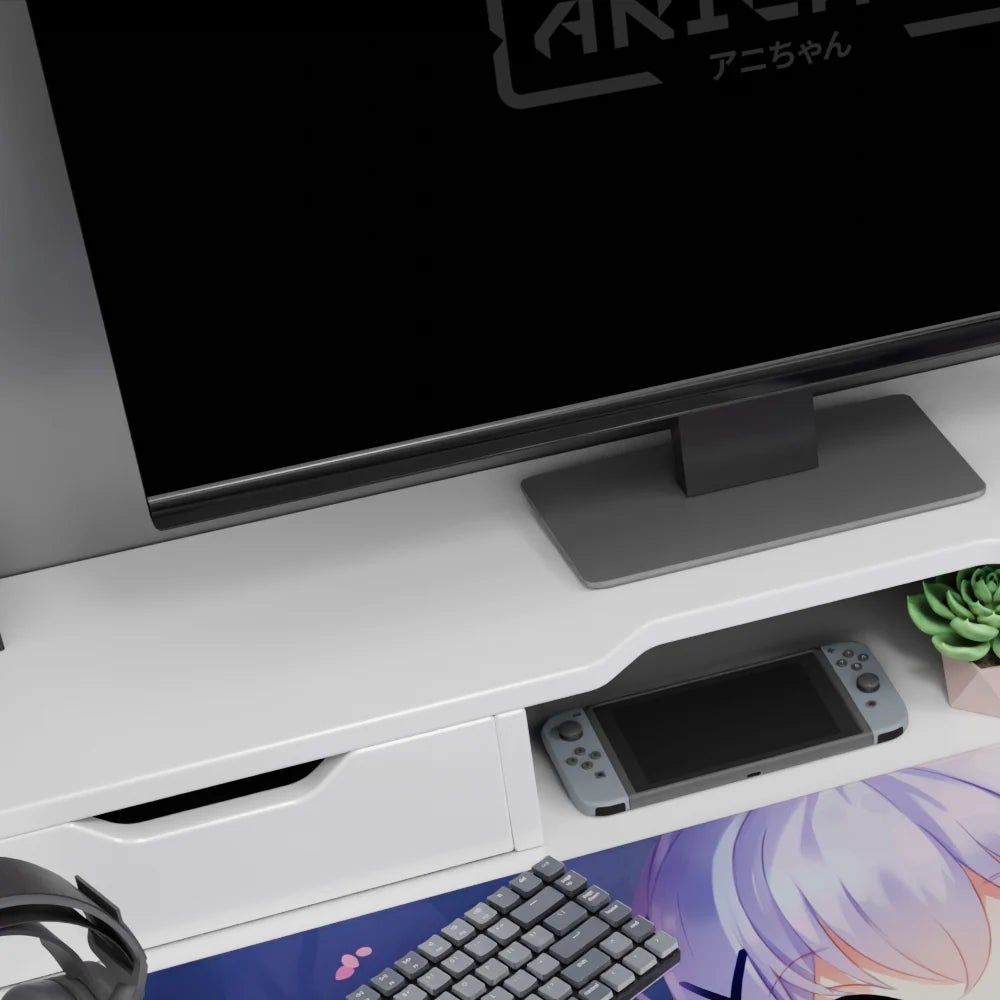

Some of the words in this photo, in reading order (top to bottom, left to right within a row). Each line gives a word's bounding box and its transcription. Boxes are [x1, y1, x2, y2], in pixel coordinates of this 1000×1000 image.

[709, 31, 852, 80] アニちゃん
